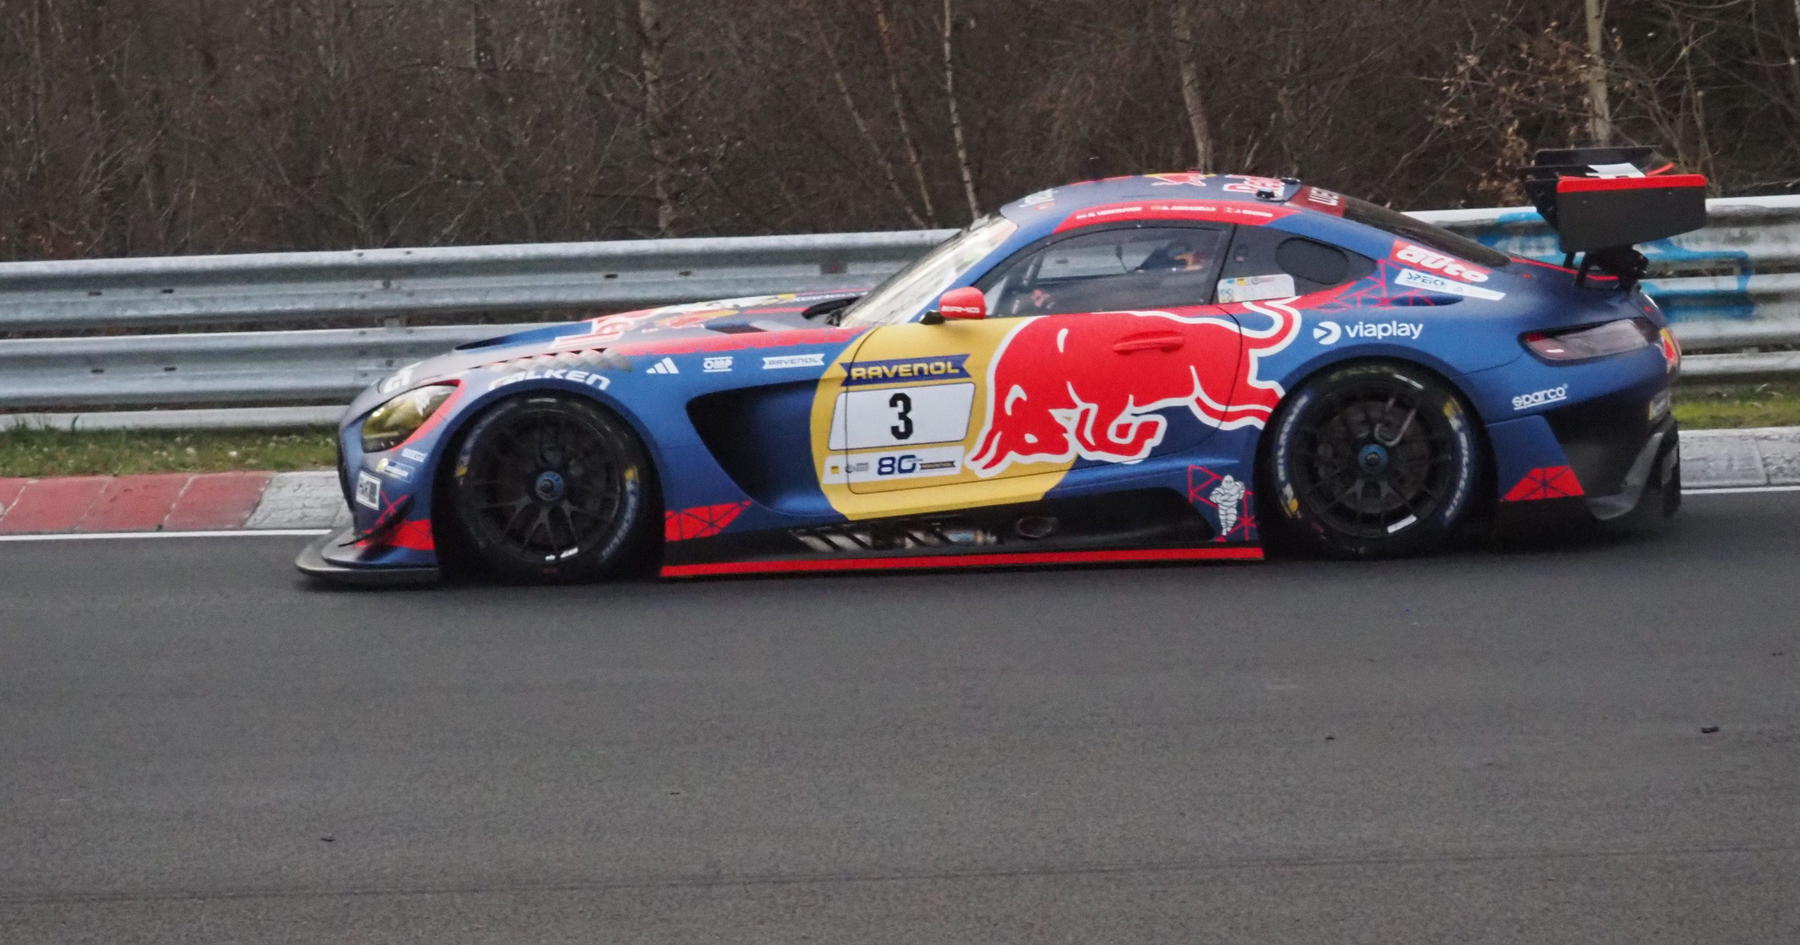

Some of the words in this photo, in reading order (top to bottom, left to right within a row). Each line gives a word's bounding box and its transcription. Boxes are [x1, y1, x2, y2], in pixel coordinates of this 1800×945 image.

[1396, 245, 1489, 282] auto
[1345, 321, 1423, 340] viaplay
[703, 358, 733, 371] OMP
[852, 362, 959, 380] RAVENOL
[487, 369, 610, 391] FALKEN
[889, 393, 913, 440] 3
[877, 455, 916, 475] 80
